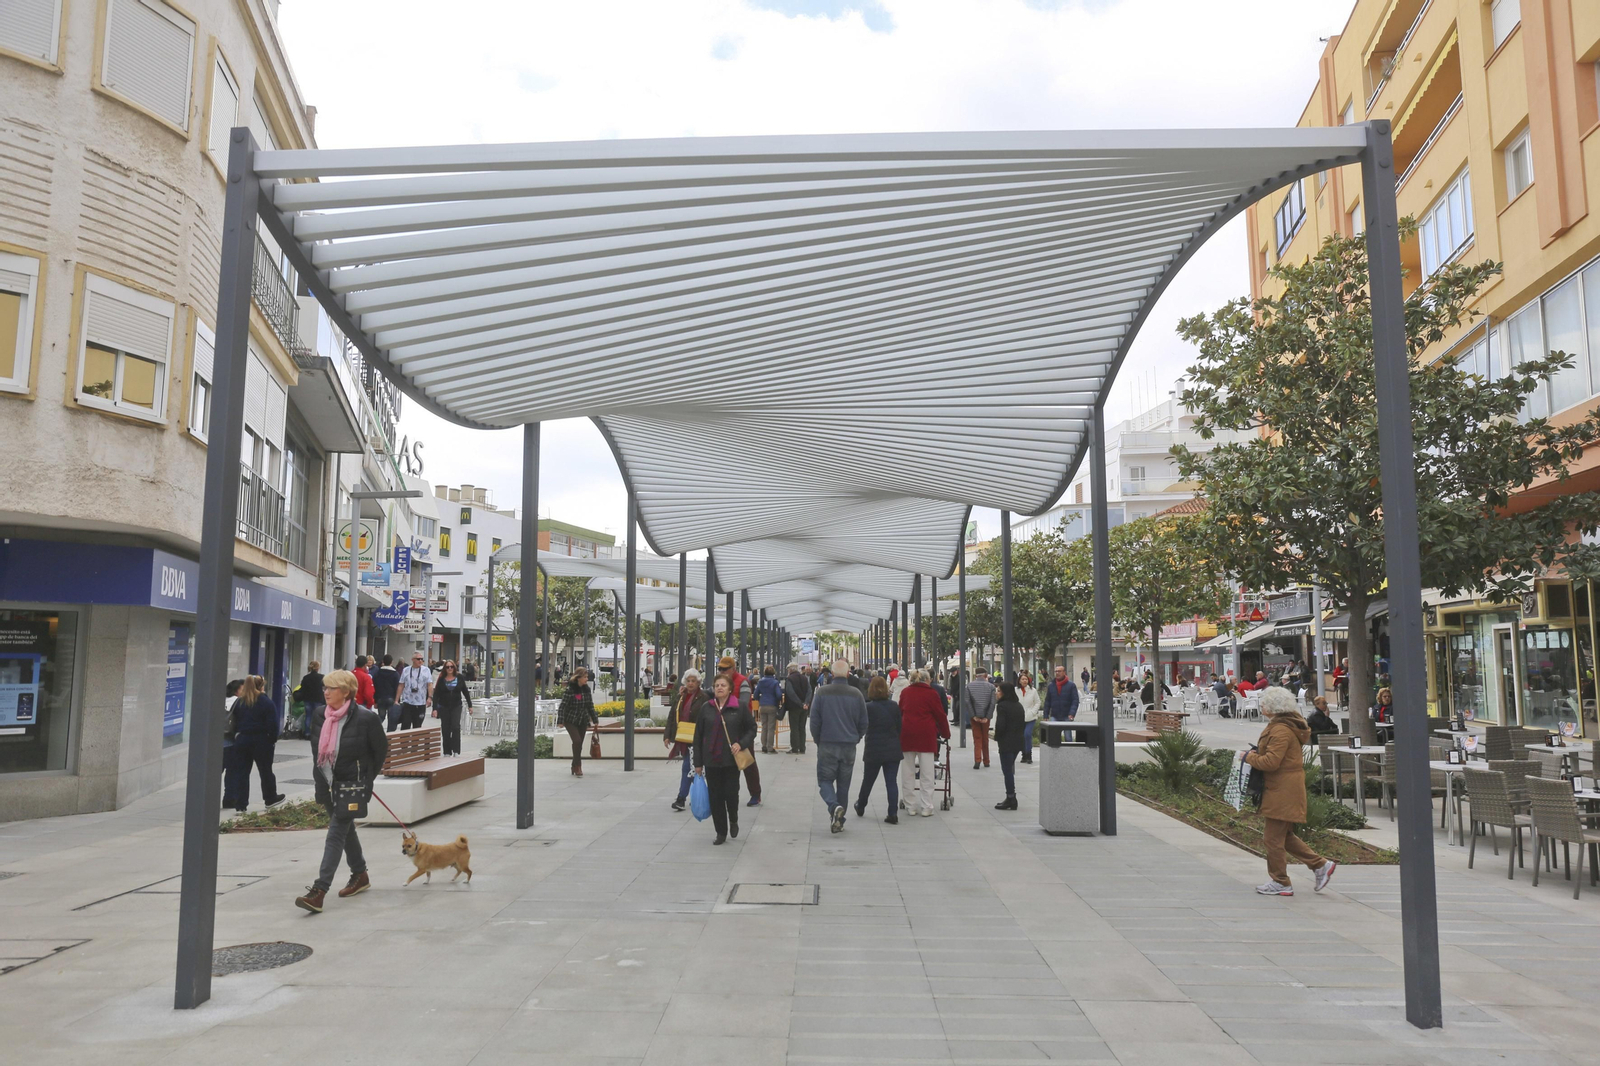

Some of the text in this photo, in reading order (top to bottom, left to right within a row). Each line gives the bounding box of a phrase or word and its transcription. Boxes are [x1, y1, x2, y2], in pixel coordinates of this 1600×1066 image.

[161, 565, 186, 600] BBVA
[234, 586, 250, 612] BBVA
[281, 600, 292, 620] BBVA
